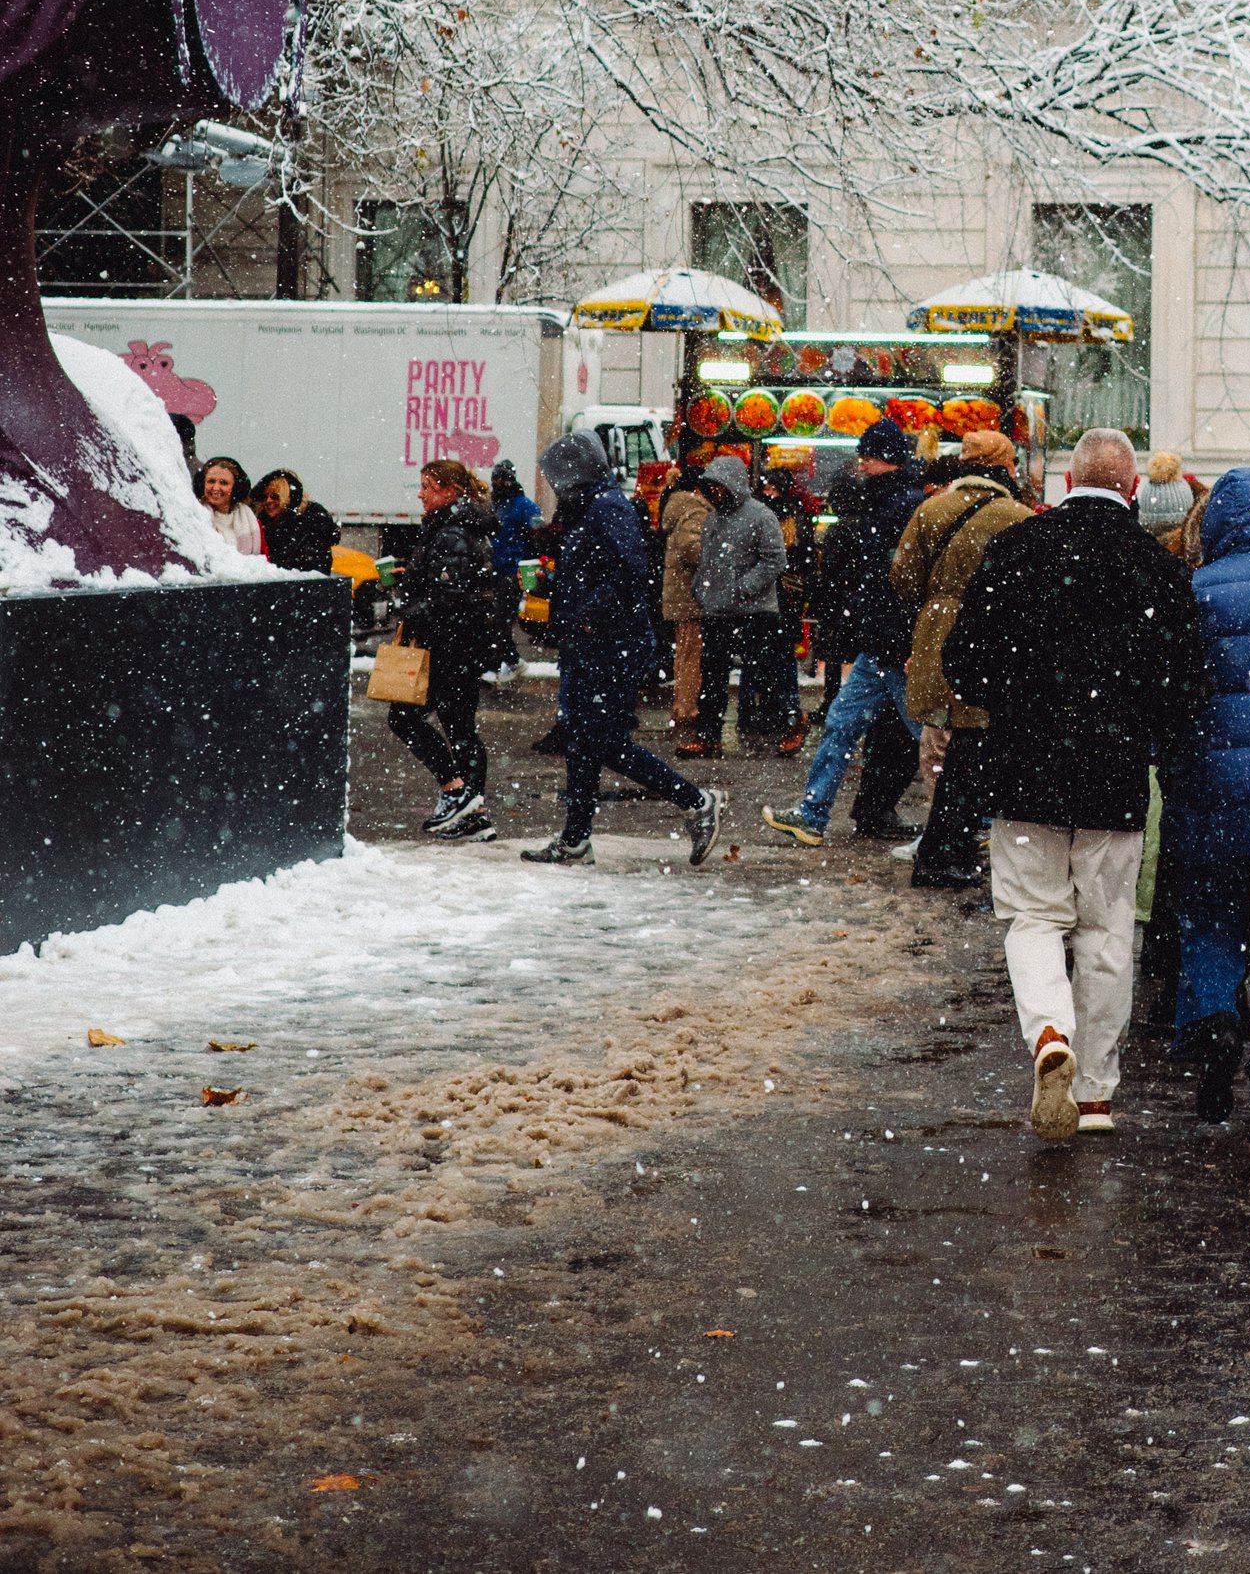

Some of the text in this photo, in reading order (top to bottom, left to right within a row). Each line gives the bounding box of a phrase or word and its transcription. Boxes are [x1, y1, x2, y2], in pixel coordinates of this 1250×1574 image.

[84, 322, 120, 332] Hamptons
[258, 324, 302, 334] Pennsylvania
[311, 325, 344, 336] Maryland
[353, 326, 395, 337] Washington
[397, 327, 407, 336] DC
[407, 360, 486, 395] PARTY
[406, 396, 493, 431] RENTAL
